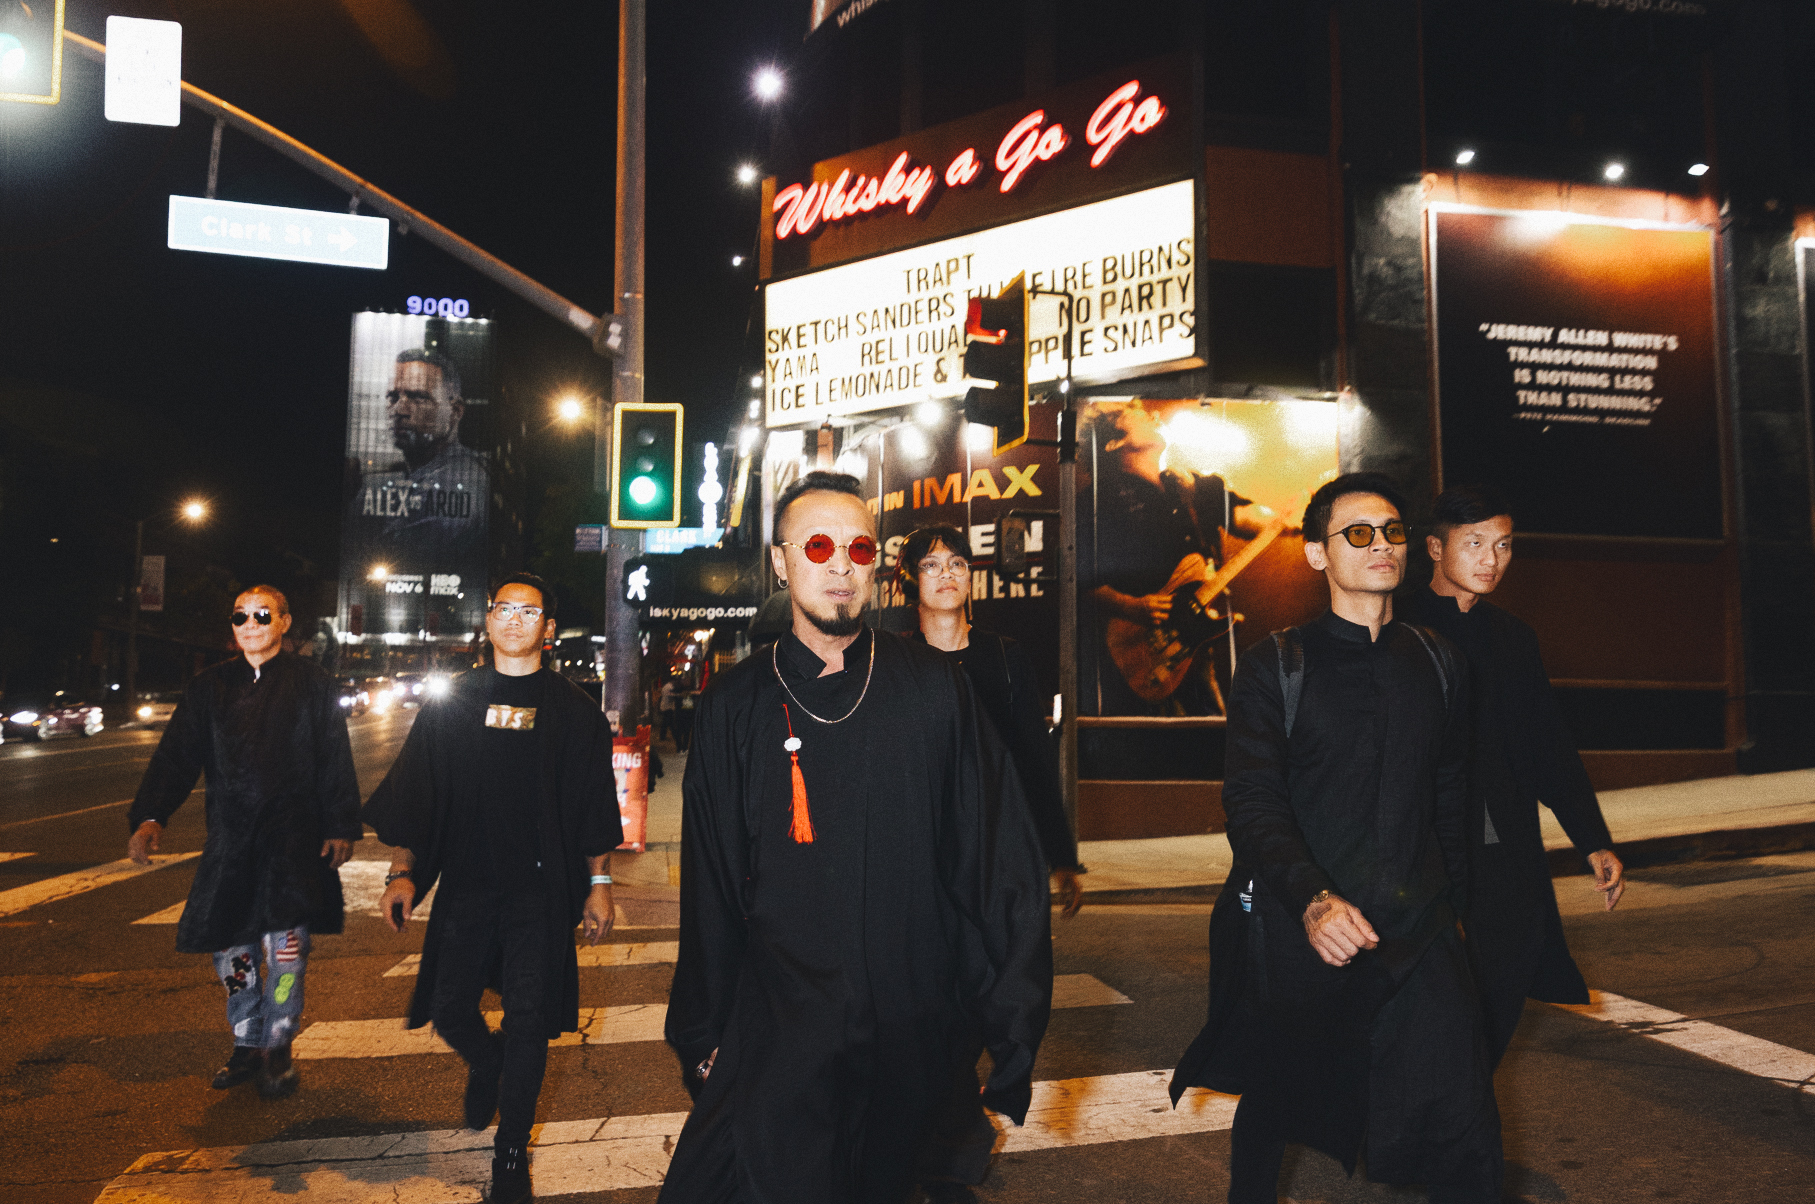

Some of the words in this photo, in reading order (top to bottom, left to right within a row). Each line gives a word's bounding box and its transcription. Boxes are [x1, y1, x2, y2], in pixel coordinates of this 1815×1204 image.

[772, 151, 933, 240] Whisky
[945, 148, 980, 188] a
[995, 109, 1068, 194] Go
[1086, 79, 1166, 168] Go
[201, 216, 272, 243] Clark
[284, 225, 313, 247] St
[903, 253, 975, 294] TRAPT
[406, 295, 470, 318] 9000
[768, 314, 849, 354] SKETCH
[856, 292, 955, 337] SANDERS
[1031, 260, 1094, 300] FIRE
[1102, 238, 1192, 286] BURNS
[768, 353, 820, 383] YAMA
[1101, 272, 1191, 320] PARTY
[1556, 328, 1610, 347] ALLEN
[772, 384, 806, 412] ICE
[815, 362, 924, 405] LEMONADE
[933, 357, 948, 384] &
[1103, 310, 1194, 353] SNAPS
[1507, 346, 1659, 371] TRANSFORMATION
[1513, 368, 1532, 385] IS
[1535, 369, 1611, 389] NOTHING
[1613, 373, 1655, 391] LESS
[1516, 390, 1563, 407] THAN
[883, 489, 905, 512] IN
[912, 464, 1043, 510] IMAX
[363, 487, 409, 517] ALEX
[656, 529, 697, 544] CLARK
[385, 581, 414, 593] NOV
[414, 582, 424, 594] 6
[649, 605, 758, 621] iskyagogo.com
[484, 708, 523, 729] BTS
[611, 752, 642, 769] KING
